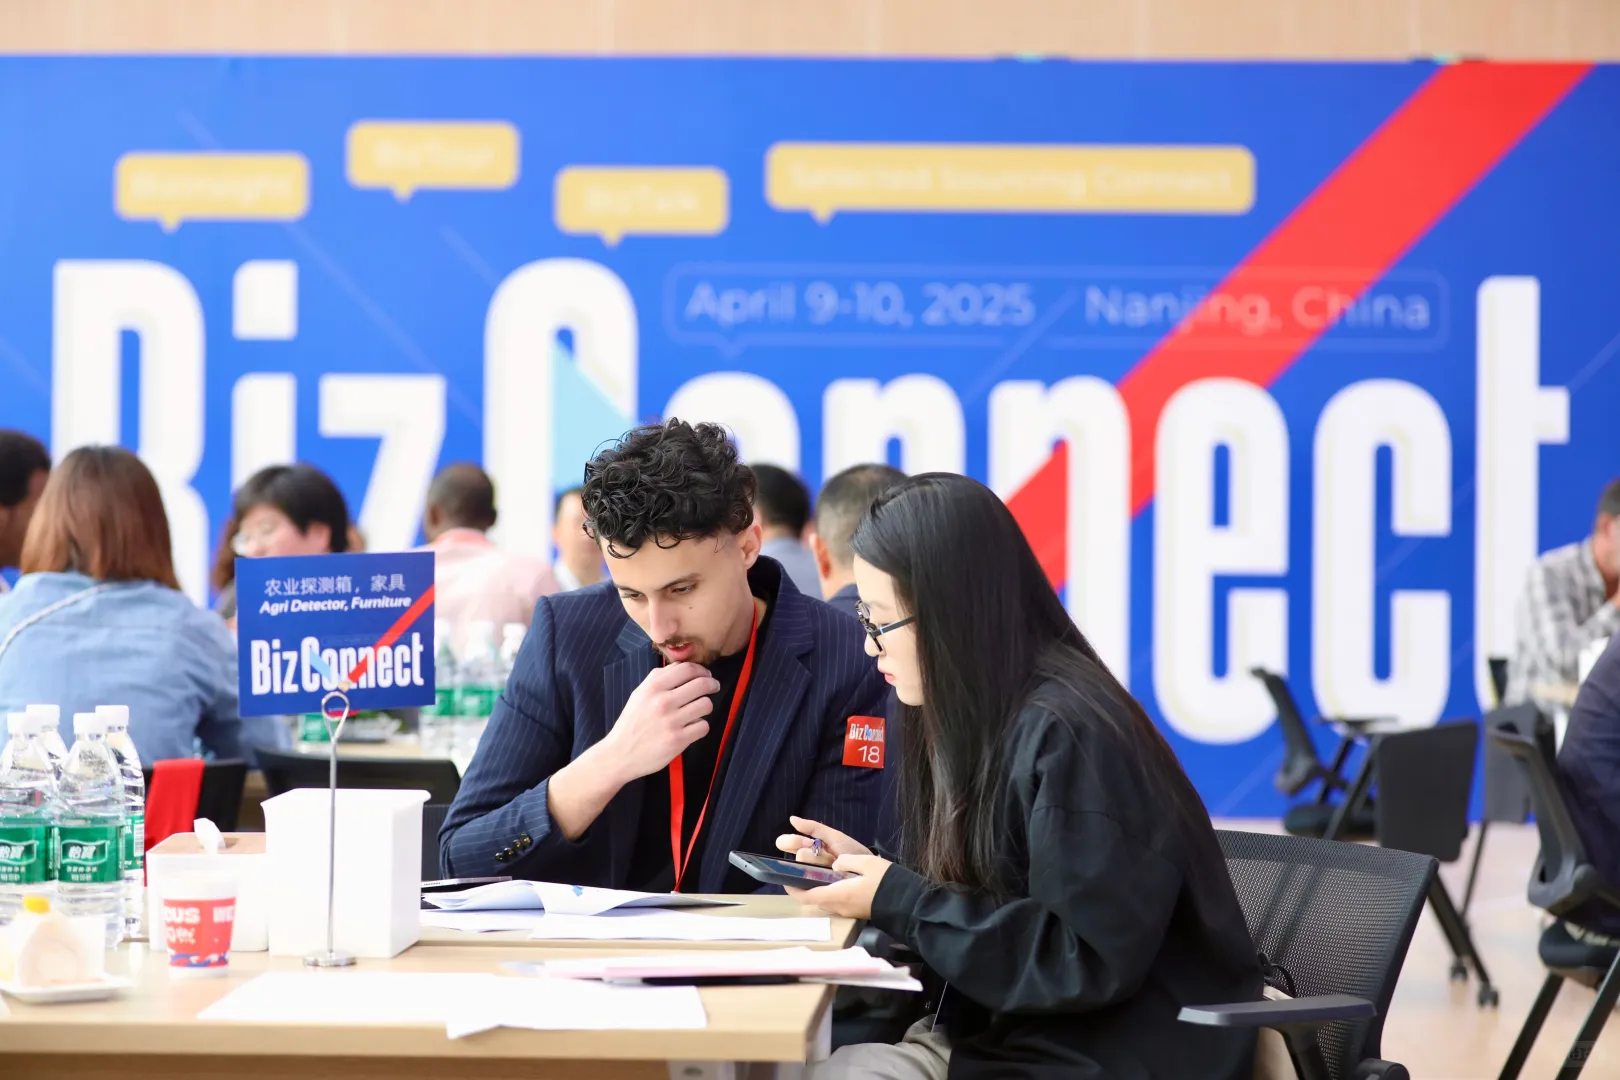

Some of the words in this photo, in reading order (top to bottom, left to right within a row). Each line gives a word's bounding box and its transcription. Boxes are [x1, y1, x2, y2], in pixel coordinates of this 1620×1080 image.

[684, 281, 796, 327] April
[921, 282, 1036, 326] 2025
[1084, 285, 1282, 336] Nanjing,
[1292, 286, 1432, 330] China
[259, 600, 289, 616] Agri
[291, 598, 349, 613] Detector,
[351, 595, 413, 610] Furniture
[857, 745, 880, 764] 18
